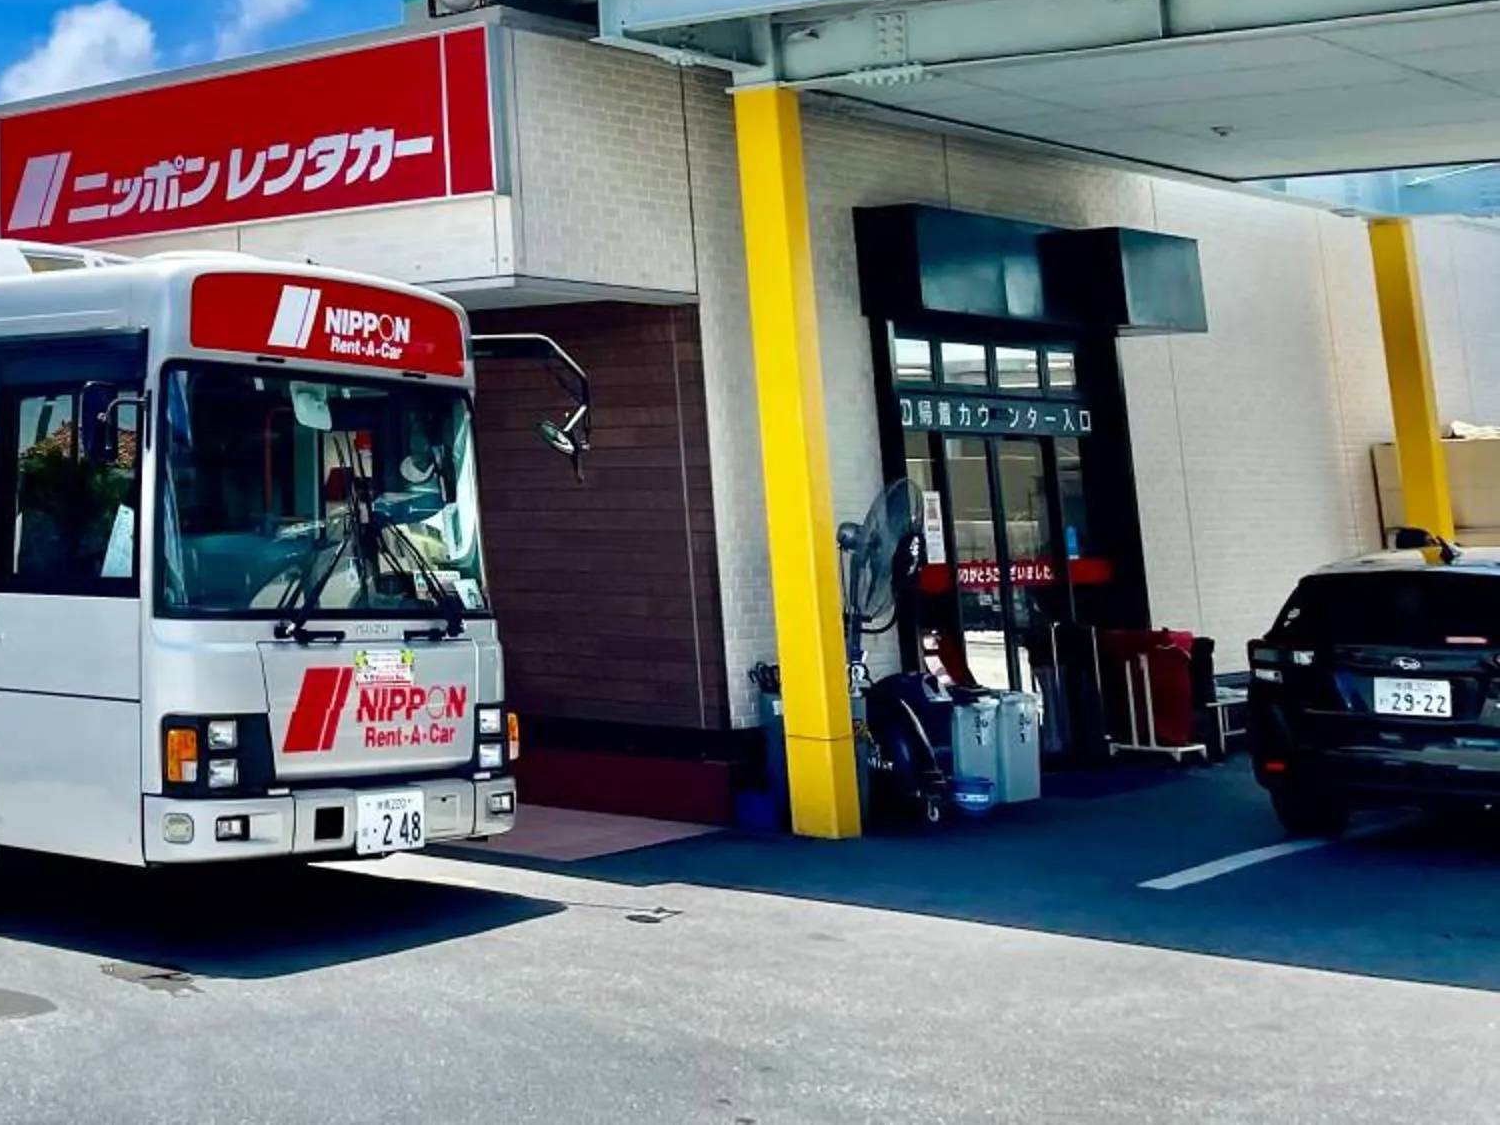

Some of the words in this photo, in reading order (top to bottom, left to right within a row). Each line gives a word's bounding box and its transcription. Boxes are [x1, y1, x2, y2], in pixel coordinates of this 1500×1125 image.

[67, 127, 434, 224] ニッポンレンタカー
[324, 306, 411, 344] NIPPON
[356, 684, 467, 723] NIPPON
